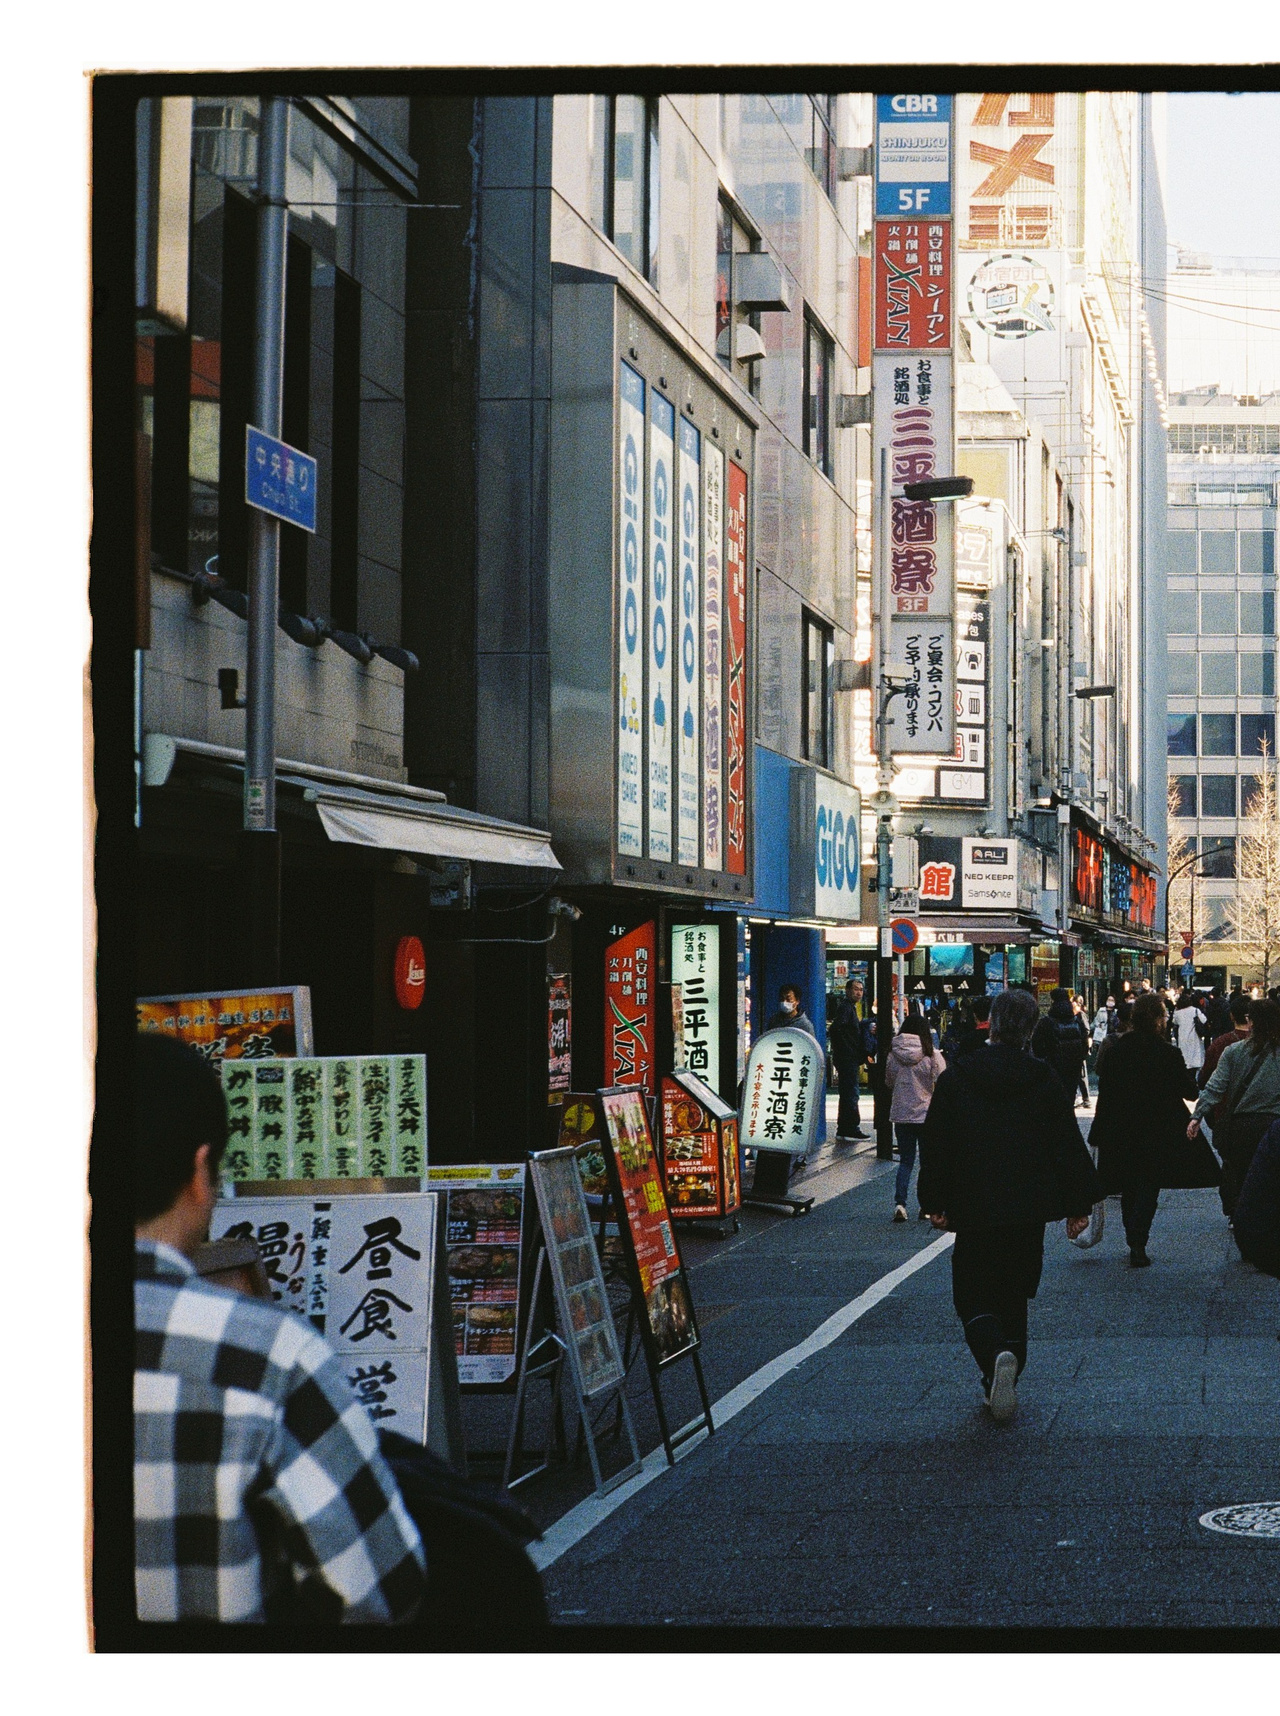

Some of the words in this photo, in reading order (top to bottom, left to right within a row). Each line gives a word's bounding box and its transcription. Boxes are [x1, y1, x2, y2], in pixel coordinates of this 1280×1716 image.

[891, 94, 938, 113] CBR
[880, 136, 948, 148] SHINJUKU
[881, 154, 919, 163] MONITOR
[921, 155, 948, 163] ROOM
[898, 188, 931, 211] 5F
[888, 226, 901, 252] 火鍋
[905, 226, 919, 265] 刀削麺
[928, 226, 944, 277] 西安料理
[926, 284, 944, 344] シーアン
[893, 366, 911, 406] 銘酒処
[916, 359, 933, 406] お食事と
[902, 598, 925, 612] 3F
[927, 634, 945, 733] ご宴会・コンパ
[814, 804, 858, 893] GiGO
[922, 865, 953, 897] 館
[964, 872, 983, 881] NEO
[985, 873, 1015, 881] KEEPR
[967, 888, 1012, 900] Samsonite
[609, 924, 627, 936] 4F
[684, 931, 695, 963] 銘酒処
[609, 957, 620, 983] 火鍋
[697, 931, 708, 974] お食事と
[635, 947, 648, 1006] 西安料理
[682, 976, 711, 1084] 三平酒
[747, 1062, 765, 1138] 大小宴会承ります
[763, 1041, 795, 1140] 三平酒寮
[790, 1054, 812, 1136] お食事と銘酒処
